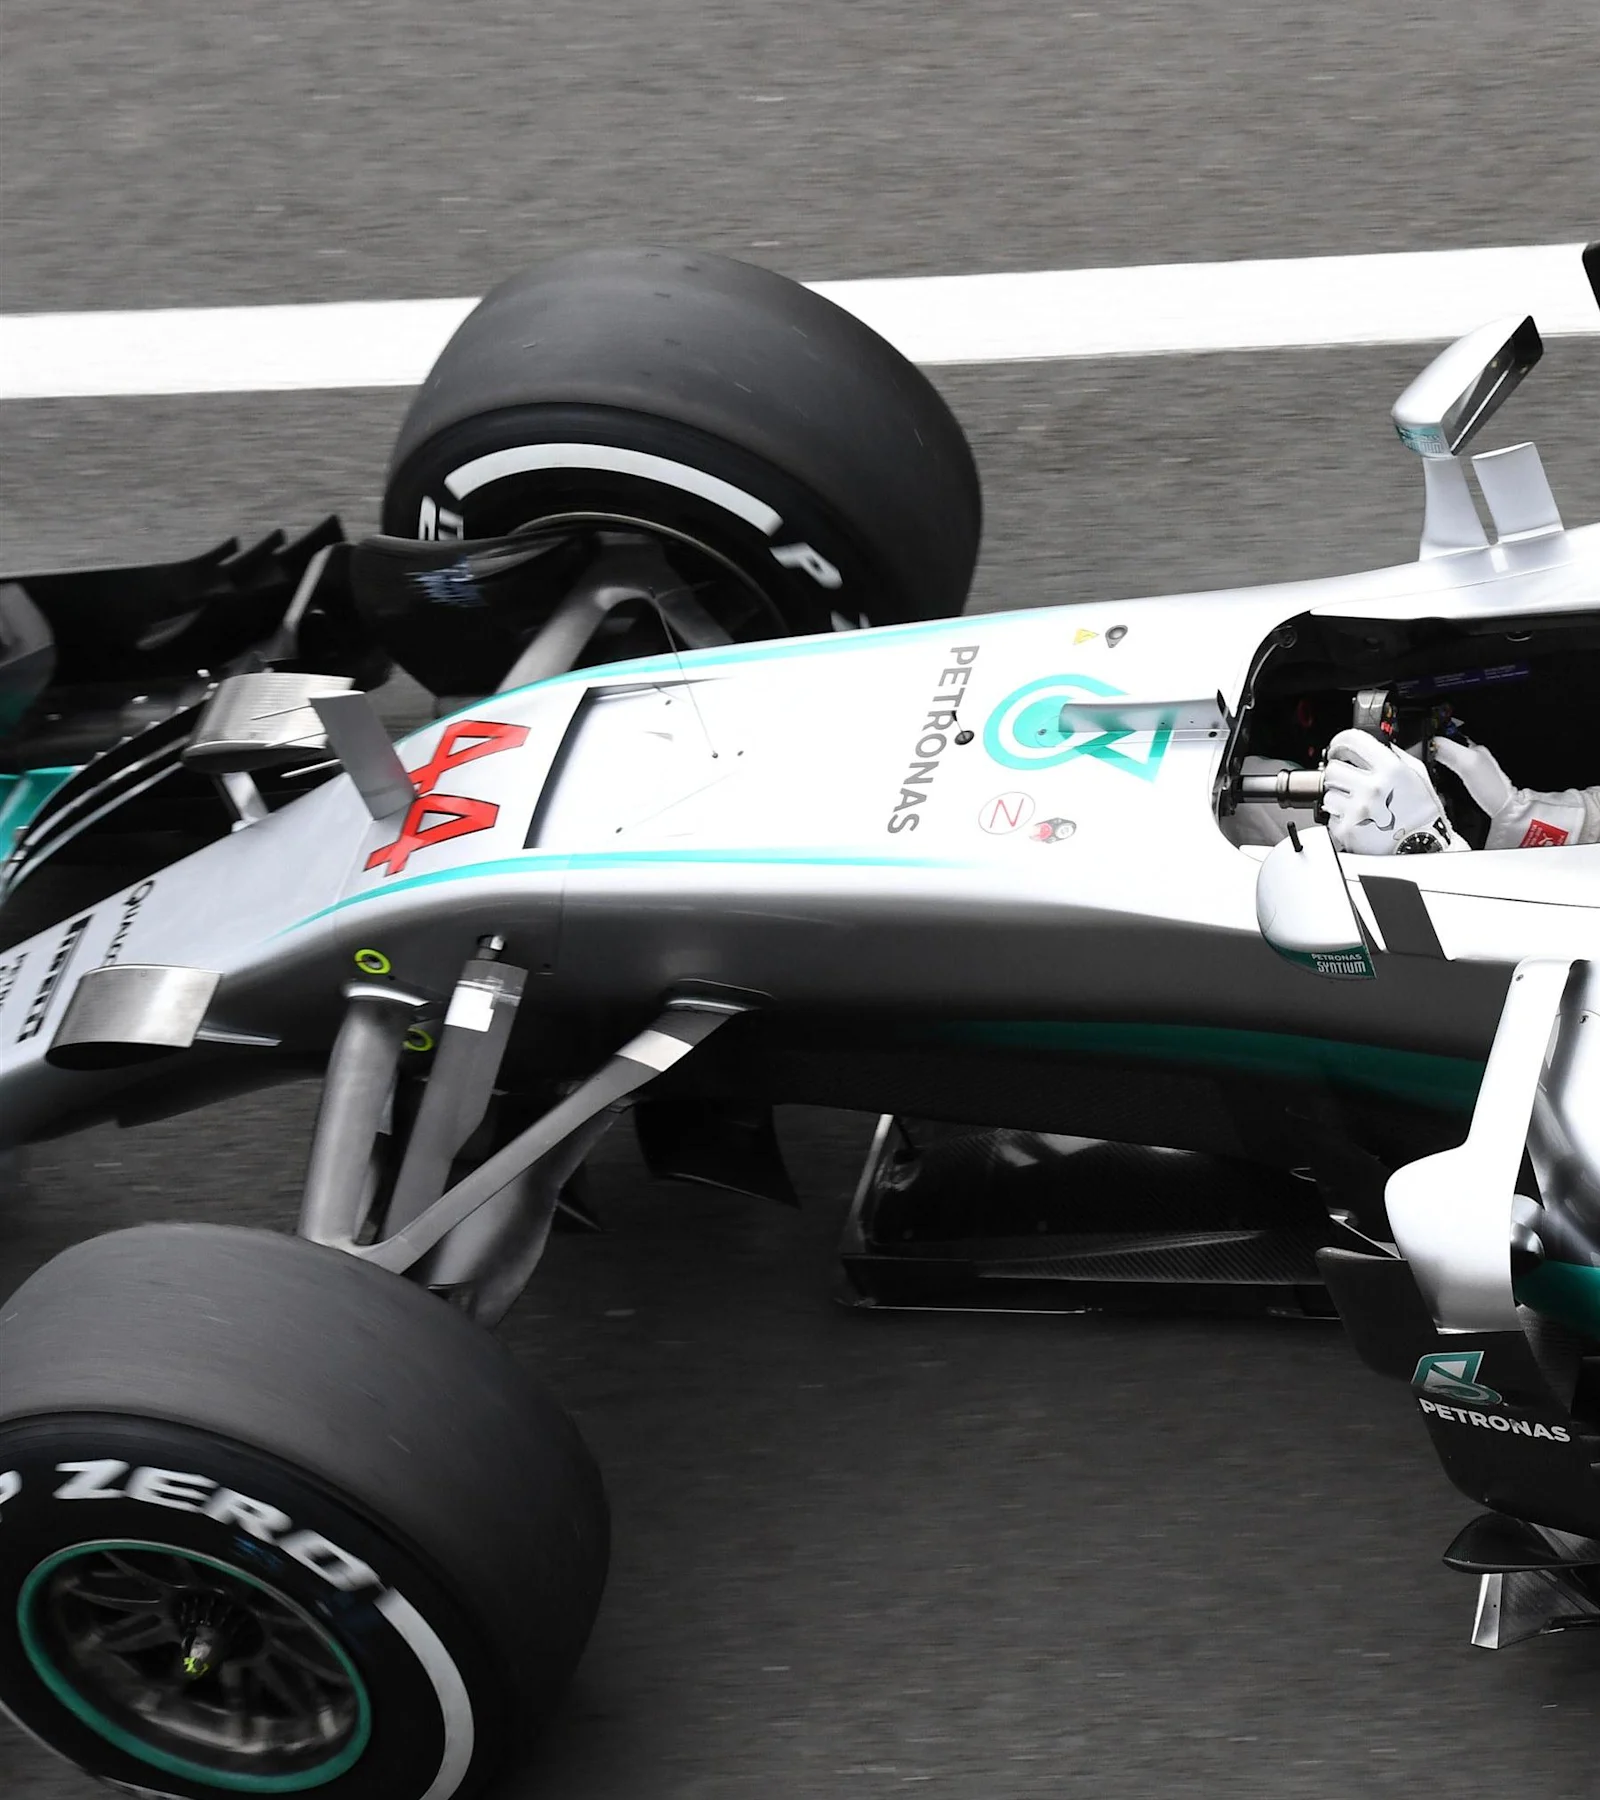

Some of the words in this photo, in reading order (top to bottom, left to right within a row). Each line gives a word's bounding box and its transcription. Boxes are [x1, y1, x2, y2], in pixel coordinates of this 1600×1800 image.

[363, 719, 531, 877] 44
[887, 645, 980, 834] PETRONAS
[1311, 953, 1362, 961] PETRONAS
[1418, 1397, 1571, 1443] PETRONAS
[52, 1458, 382, 1592] ZERO
